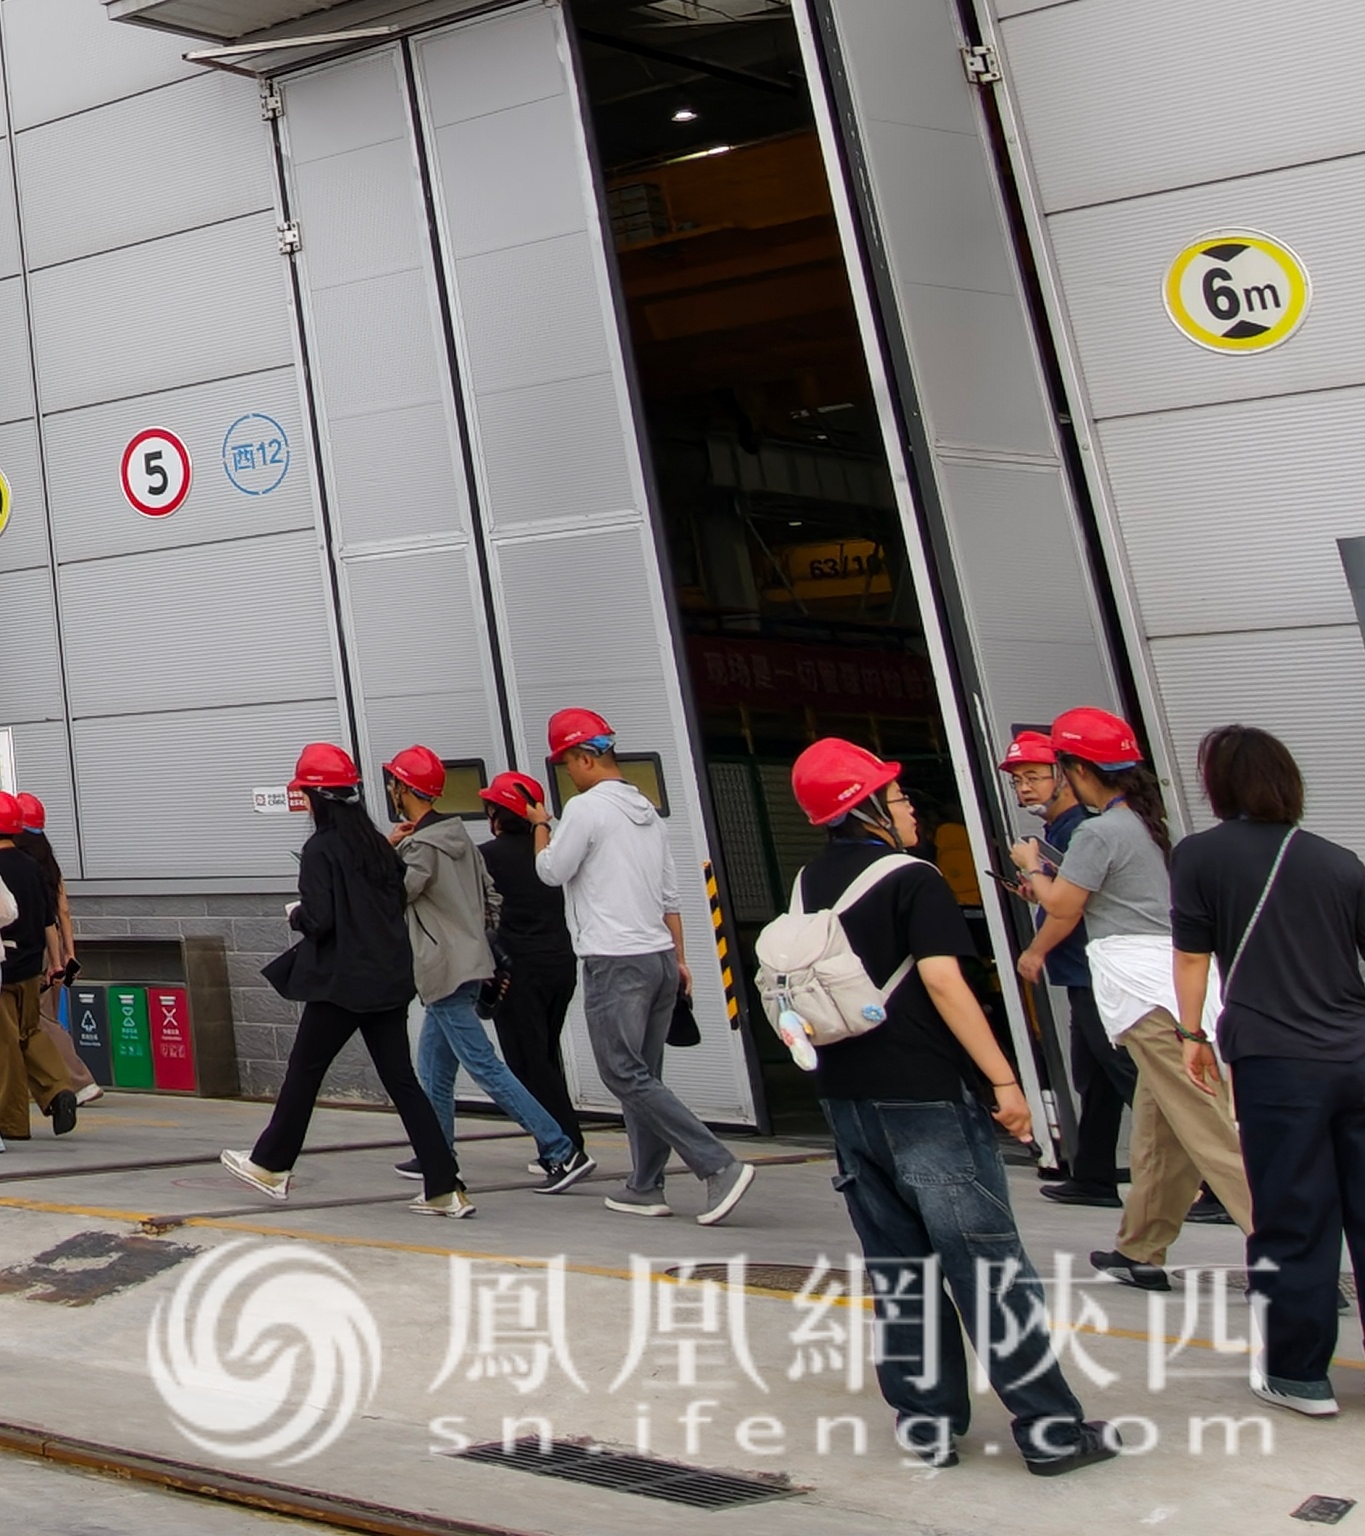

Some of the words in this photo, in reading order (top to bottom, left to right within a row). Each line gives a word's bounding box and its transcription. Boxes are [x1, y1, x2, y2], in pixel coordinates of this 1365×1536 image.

[1202, 267, 1282, 322] 6m
[144, 450, 169, 496] 5
[231, 438, 284, 473] 西12
